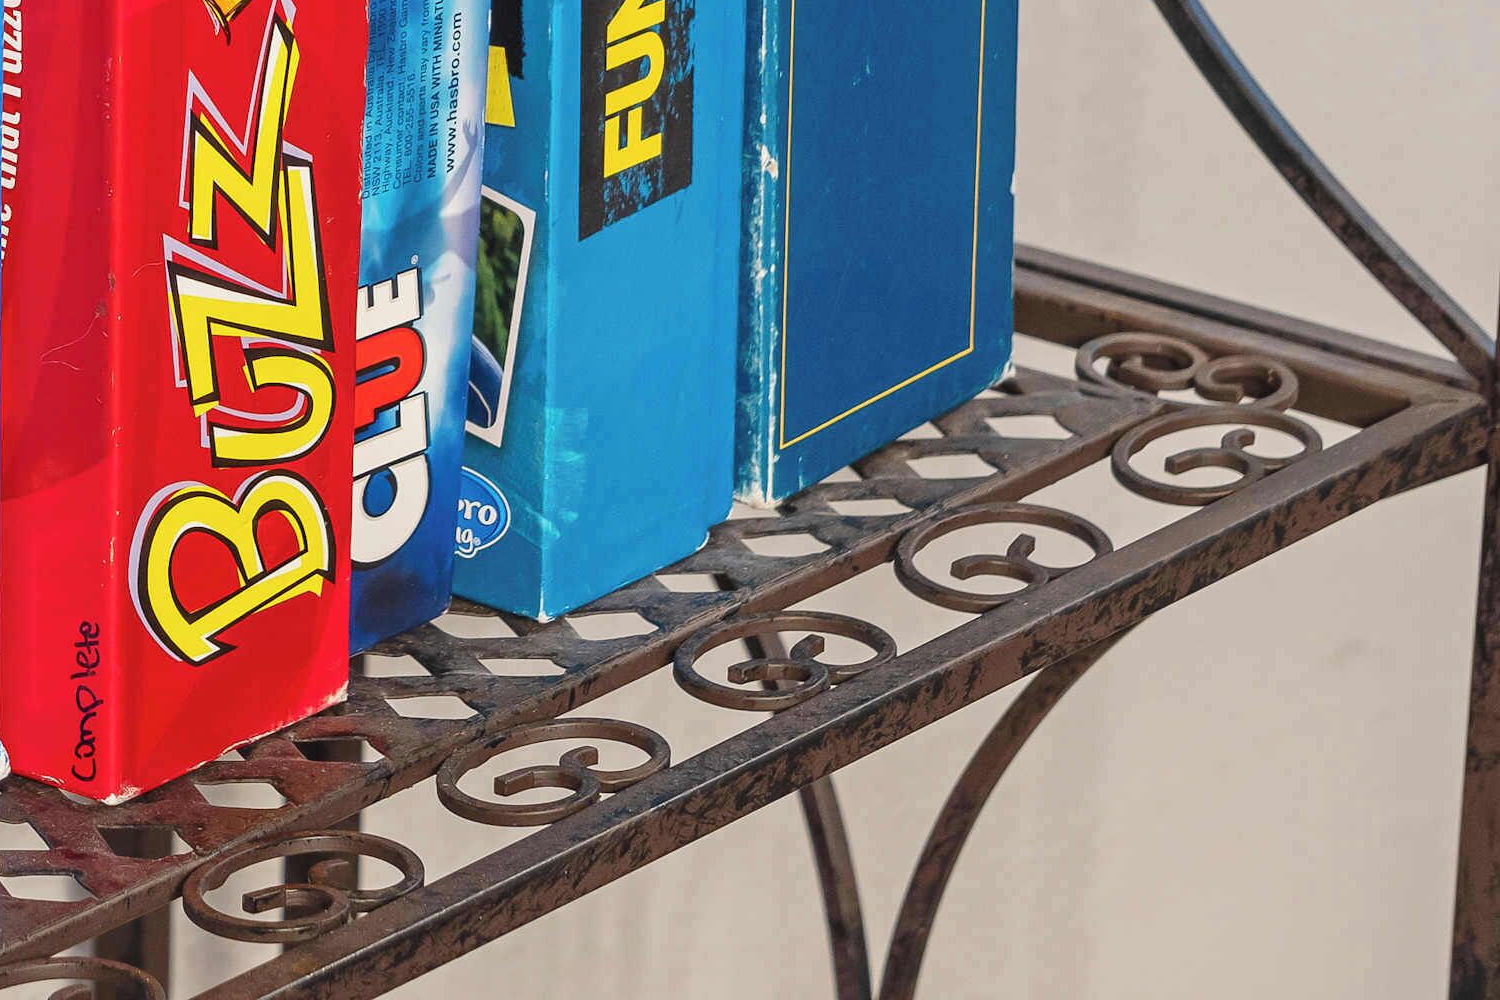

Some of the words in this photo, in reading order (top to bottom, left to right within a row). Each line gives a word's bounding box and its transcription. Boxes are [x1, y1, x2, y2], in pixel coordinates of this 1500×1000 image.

[430, 55, 442, 89] WITH
[429, 93, 440, 119] USA
[446, 12, 462, 172] www.hasbro.com
[428, 123, 439, 135] IN
[427, 139, 438, 178] MADE
